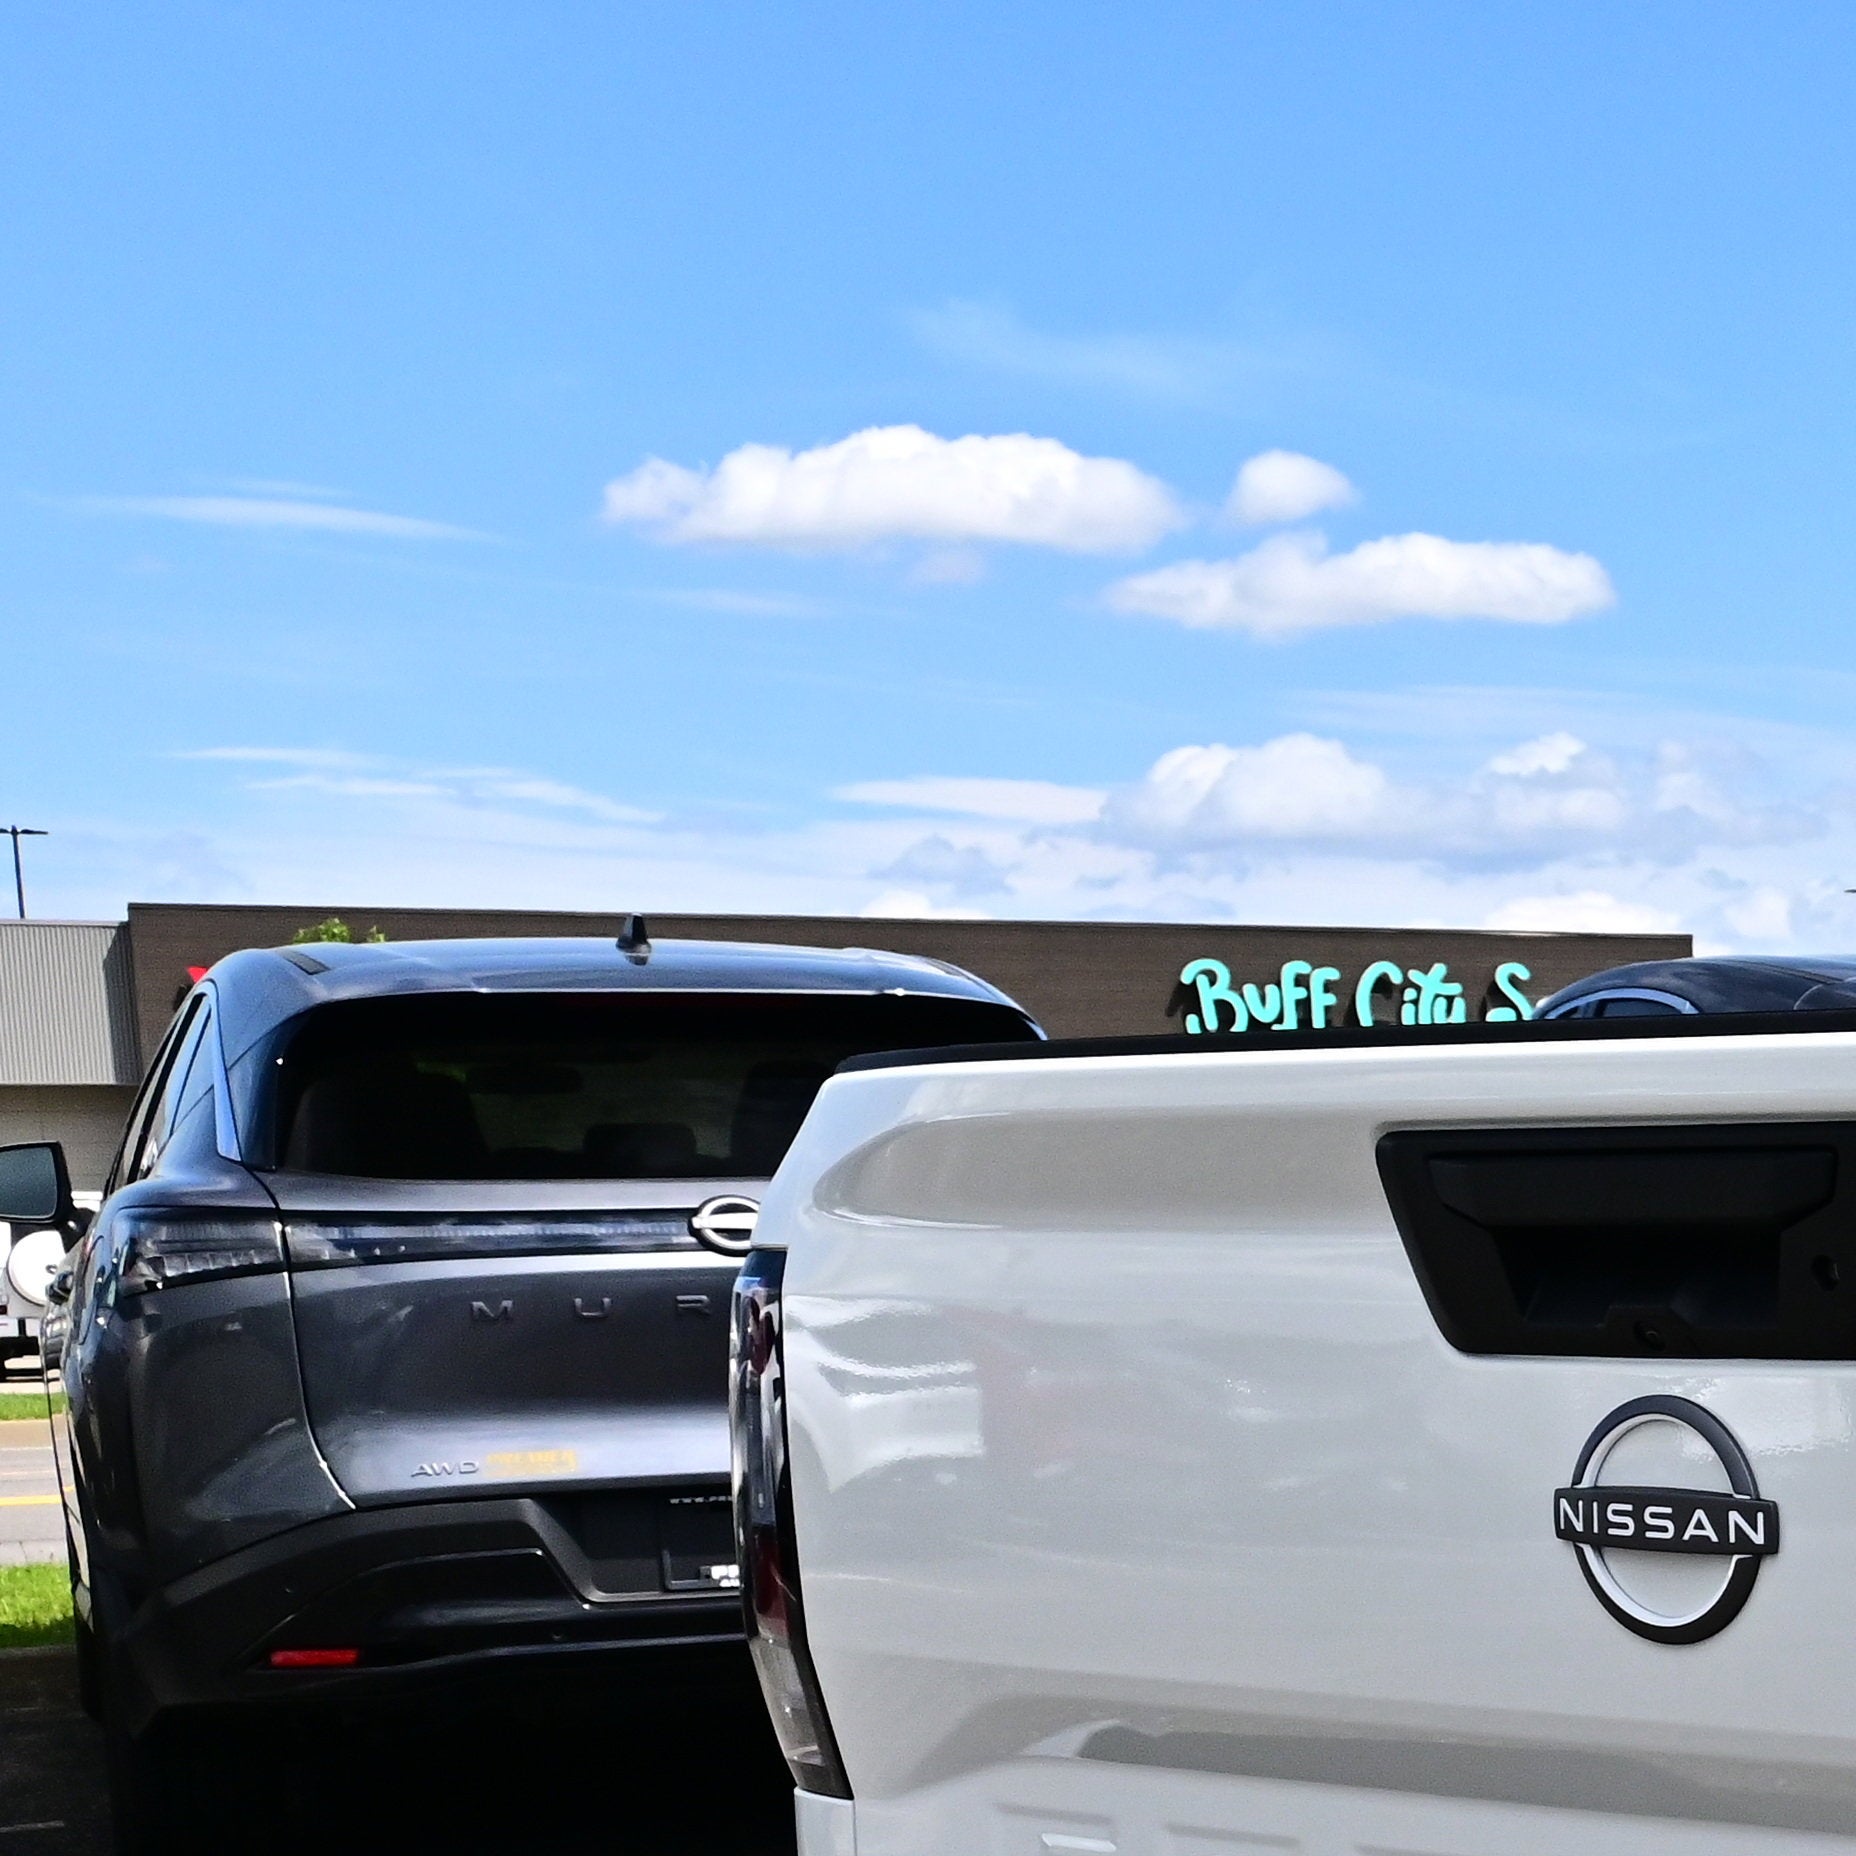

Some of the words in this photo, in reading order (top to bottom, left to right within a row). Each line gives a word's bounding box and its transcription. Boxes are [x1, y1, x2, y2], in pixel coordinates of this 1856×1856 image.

[1180, 957, 1340, 1033] Buff
[411, 1460, 480, 1478] AWD
[1558, 1496, 1766, 1546] NISSAN
